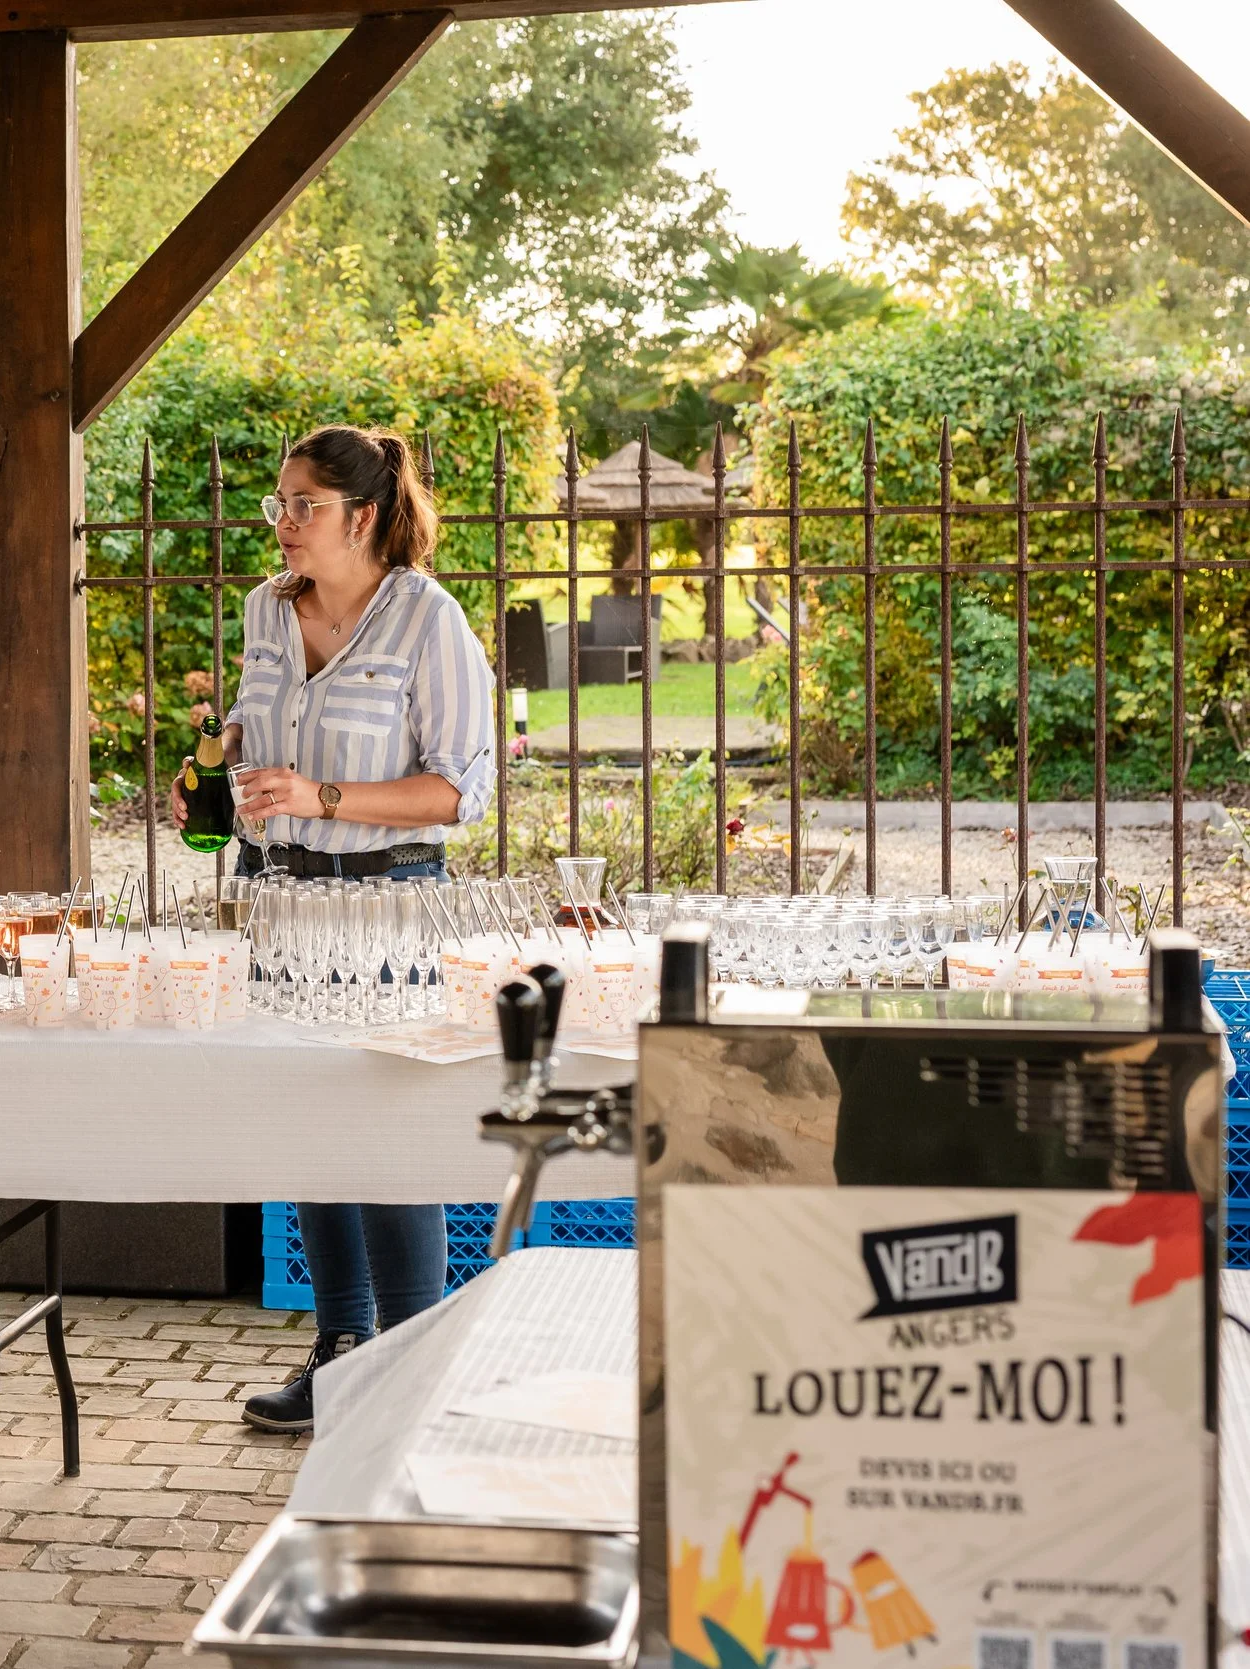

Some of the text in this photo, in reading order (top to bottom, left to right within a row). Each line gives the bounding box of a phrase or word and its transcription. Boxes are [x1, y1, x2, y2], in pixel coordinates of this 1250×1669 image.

[874, 1230, 1005, 1302] VandB
[888, 1308, 1016, 1350] ANGERS
[752, 1355, 1095, 1426] LOUEZ-MOI
[858, 1456, 1017, 1484] DEVIS ICI OU
[847, 1488, 895, 1510] SUR
